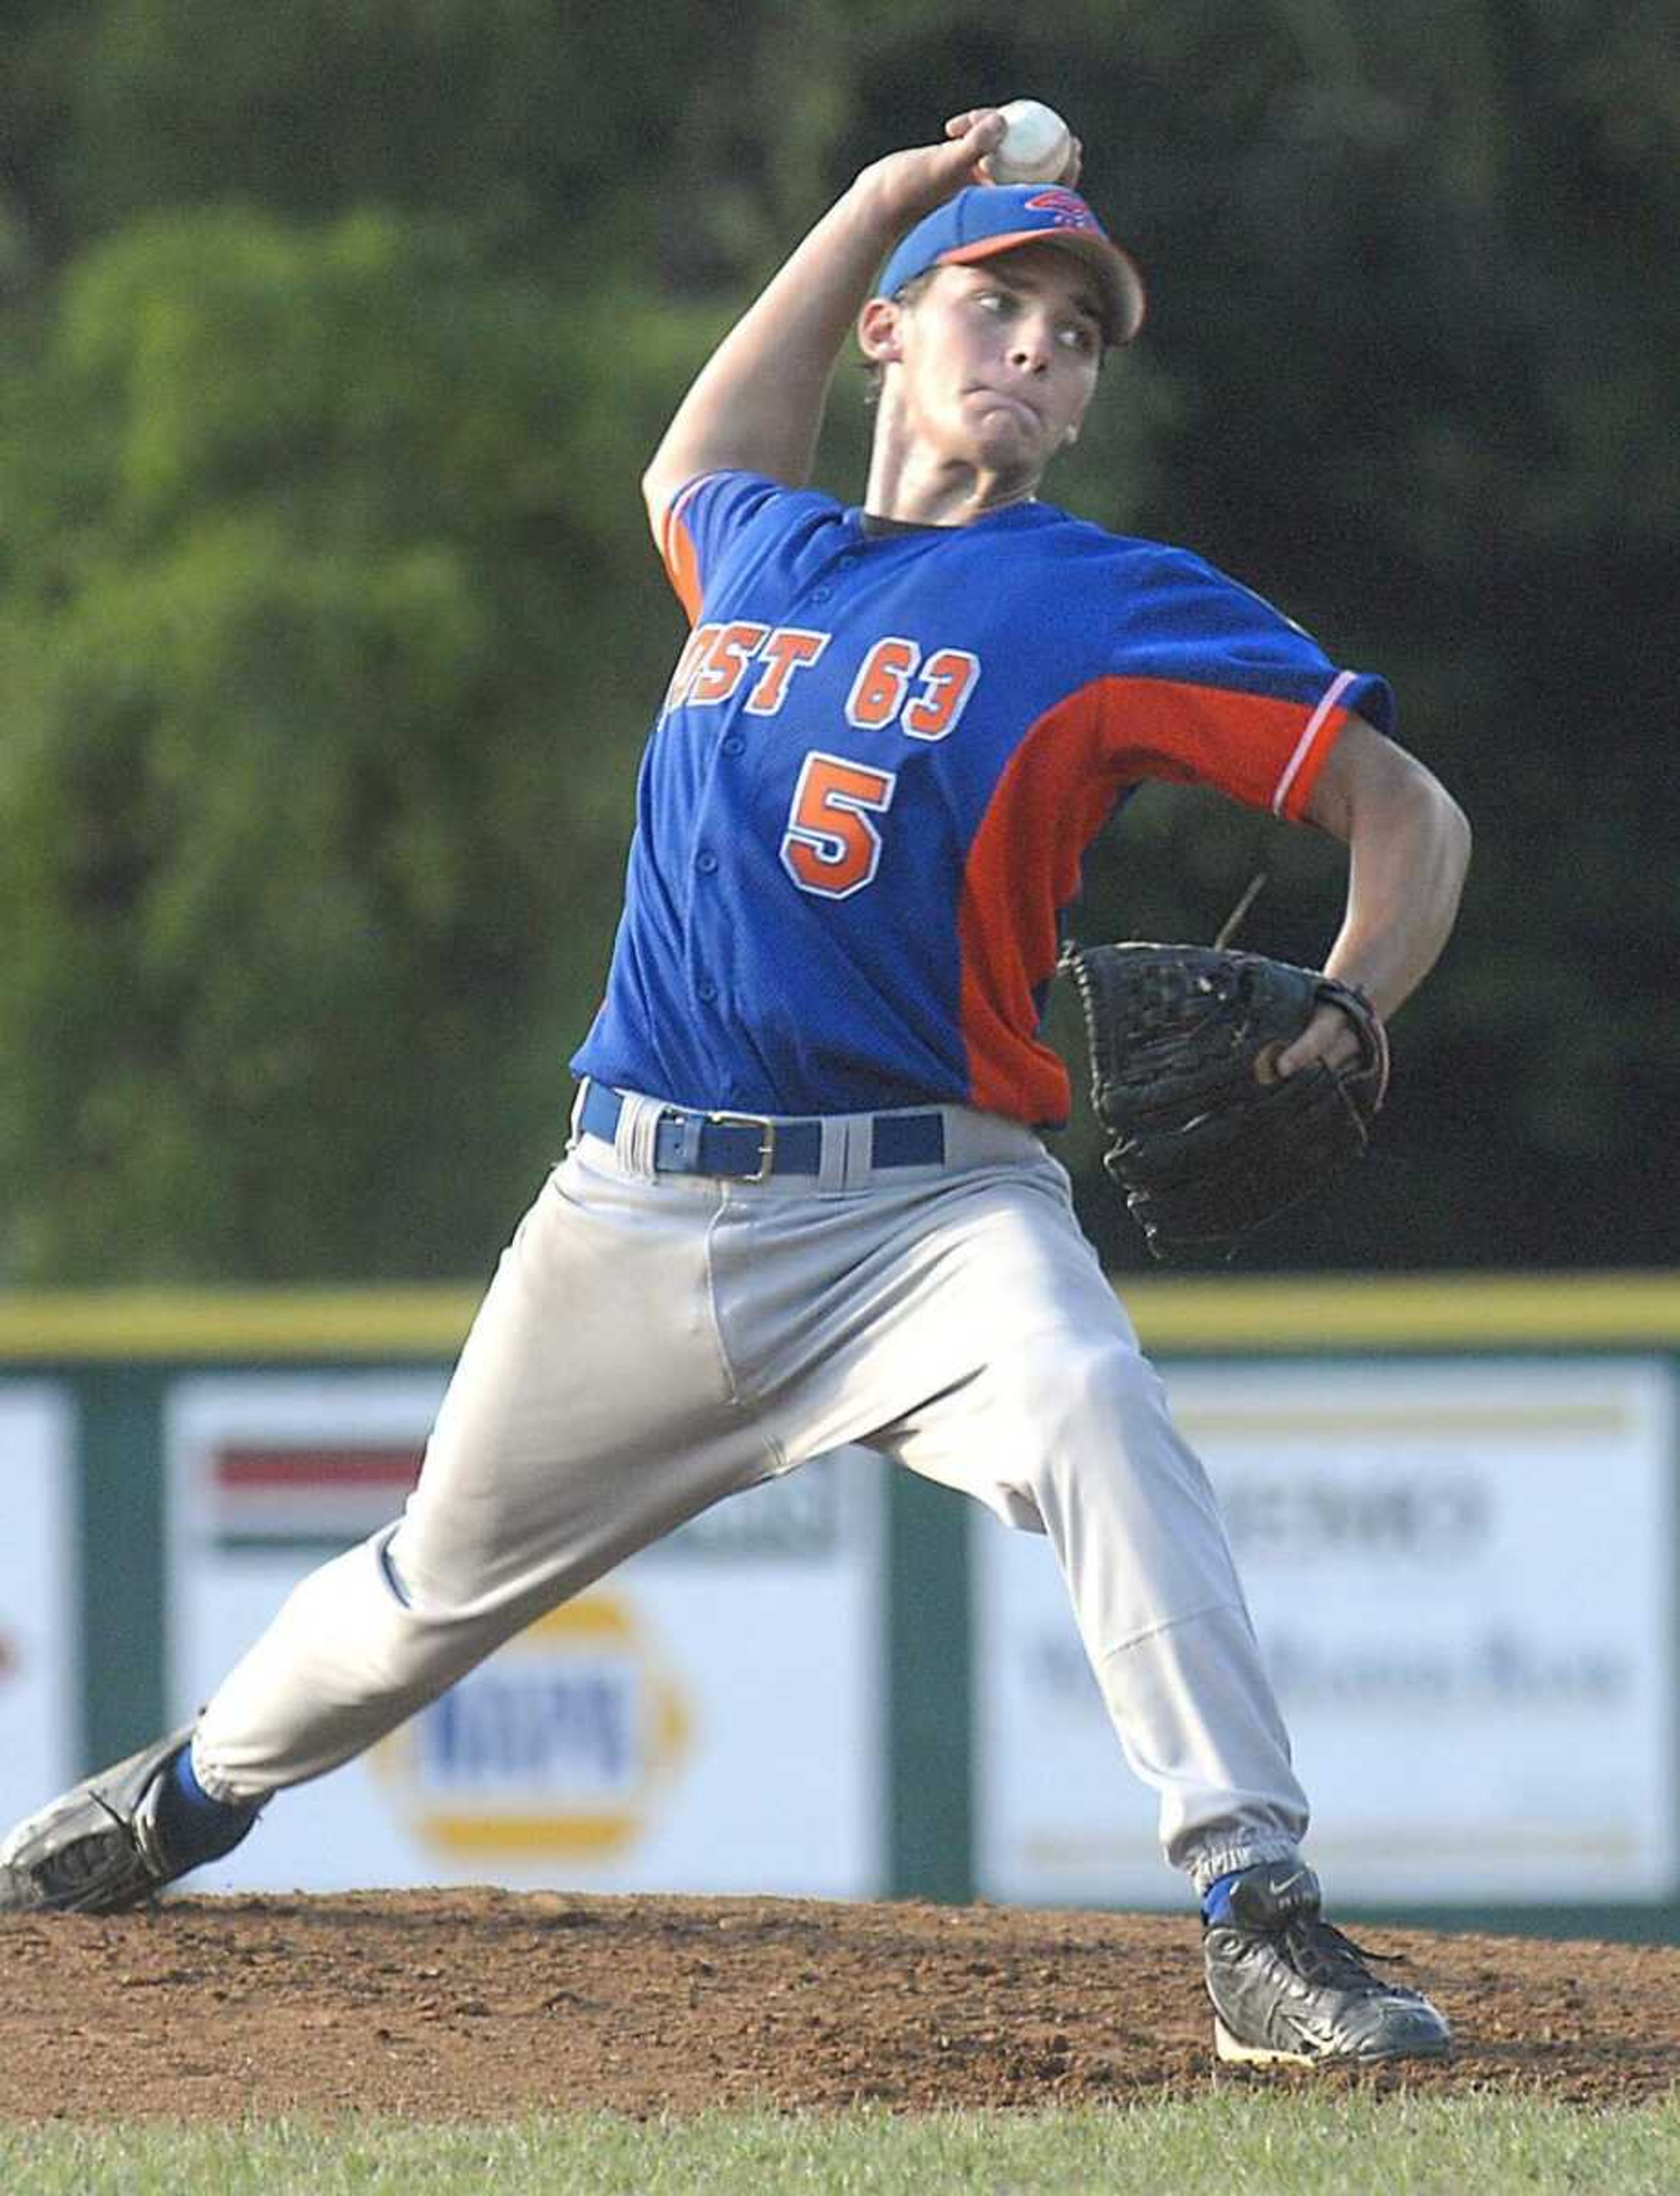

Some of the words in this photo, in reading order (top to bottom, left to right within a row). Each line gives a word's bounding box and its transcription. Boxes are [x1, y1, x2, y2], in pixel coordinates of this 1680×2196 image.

[658, 621, 831, 726] OST
[845, 637, 981, 740] 63
[780, 750, 896, 899] 5
